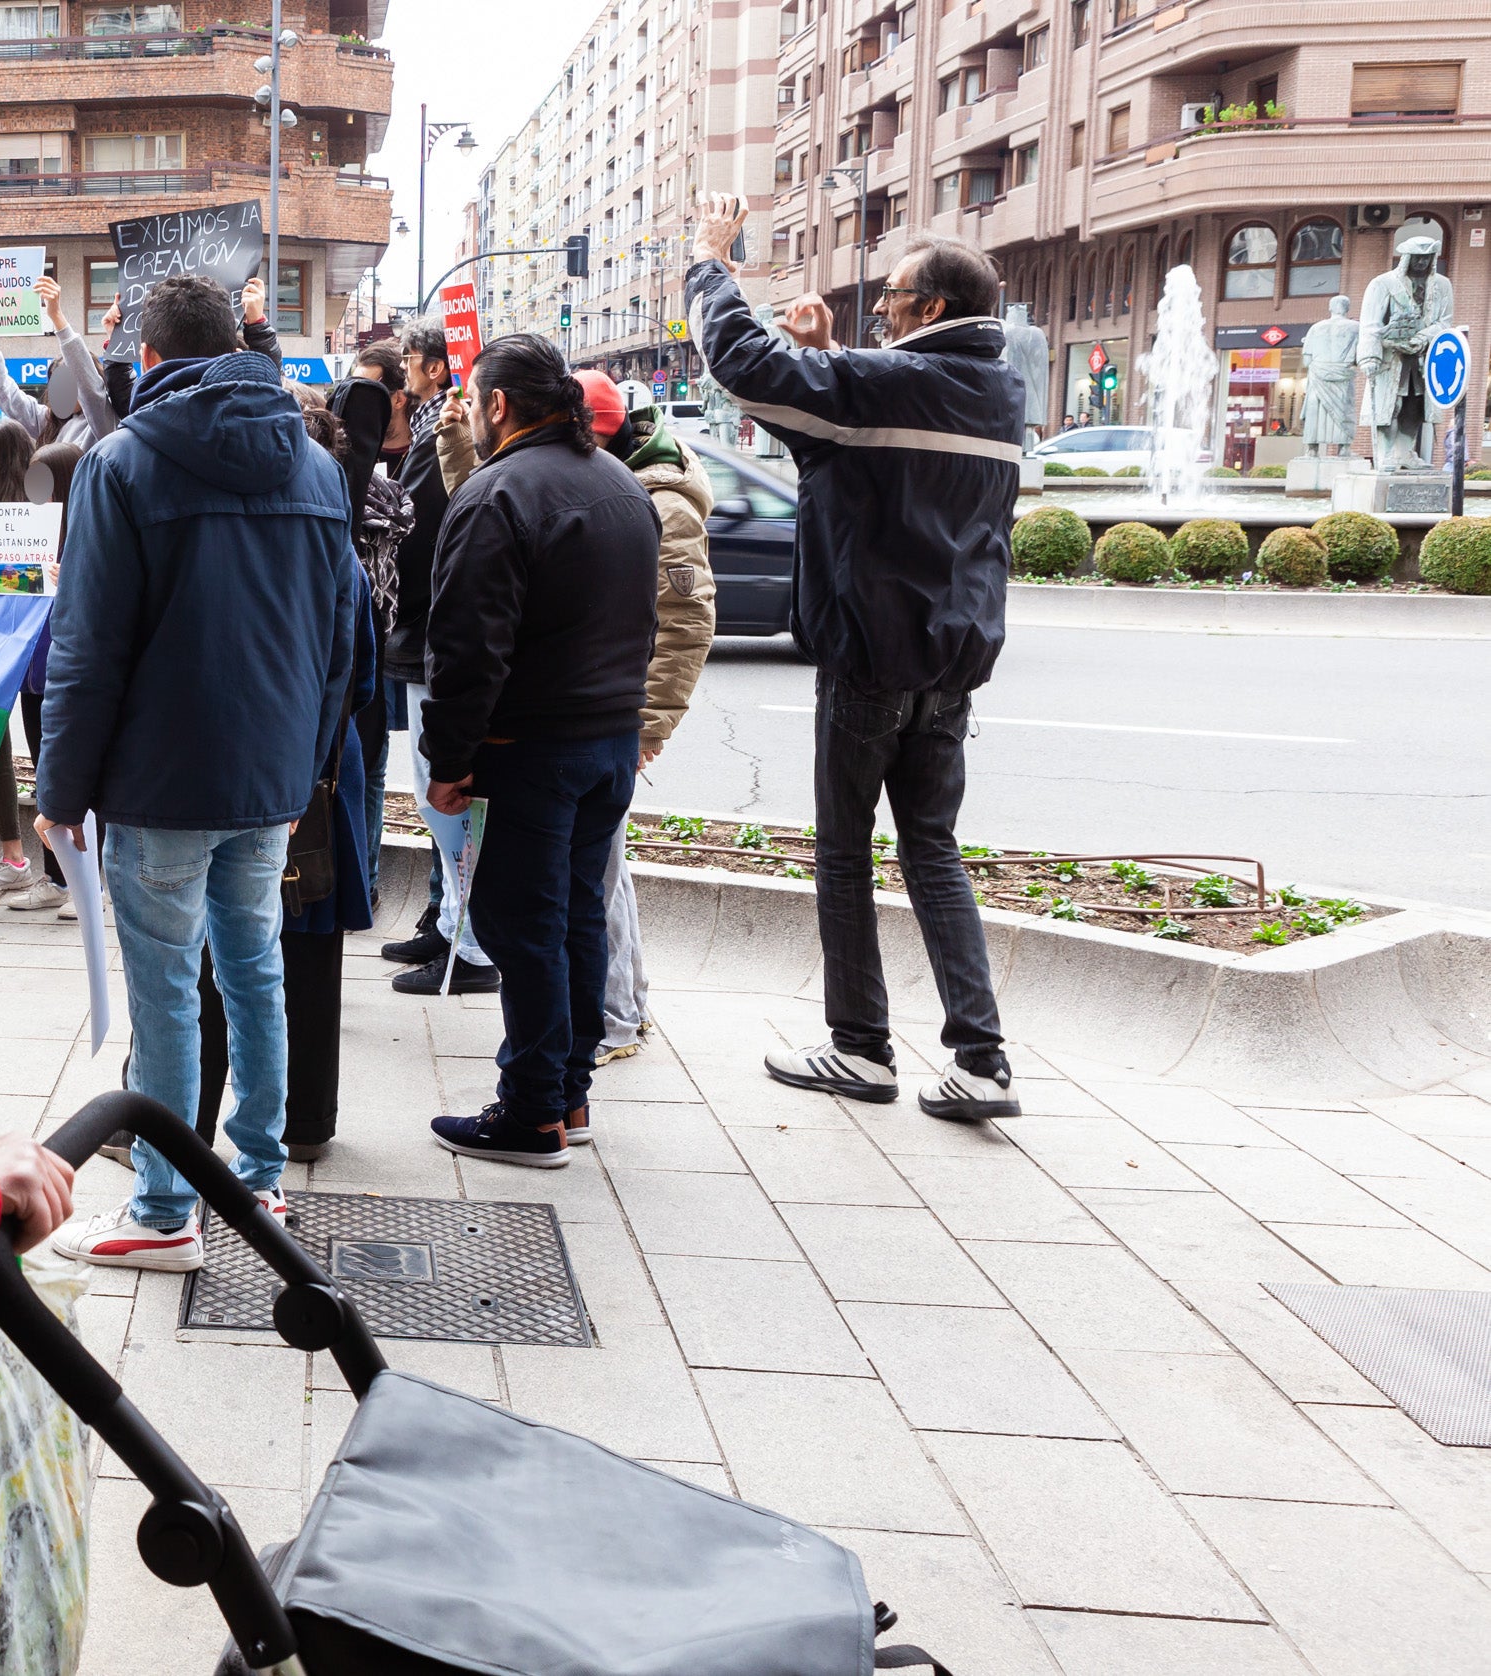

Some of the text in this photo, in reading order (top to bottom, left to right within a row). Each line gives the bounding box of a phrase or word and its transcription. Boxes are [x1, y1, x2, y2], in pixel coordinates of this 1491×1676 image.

[240, 205, 261, 228] LA
[123, 236, 242, 280] CREACIÓN
[111, 341, 136, 356] LA
[284, 363, 311, 380] ayo
[5, 523, 15, 532] EL
[0, 553, 21, 561] PASO
[24, 553, 54, 562] ATRÁS
